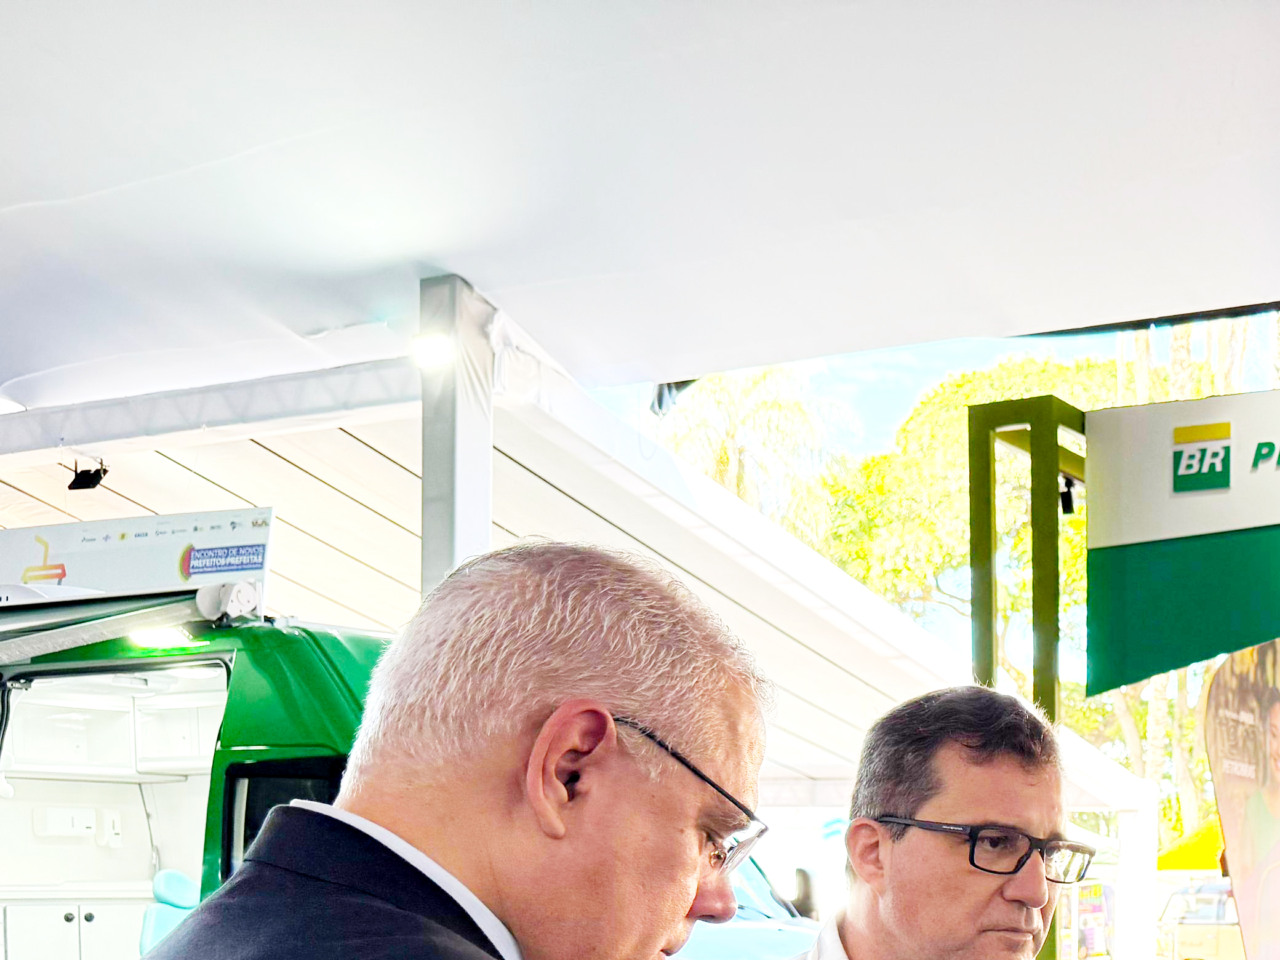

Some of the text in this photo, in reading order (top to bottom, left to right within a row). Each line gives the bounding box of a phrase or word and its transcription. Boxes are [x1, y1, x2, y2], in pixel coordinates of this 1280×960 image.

[1177, 446, 1225, 475] BR
[191, 546, 263, 560] ENCONTRO DE NOVOS
